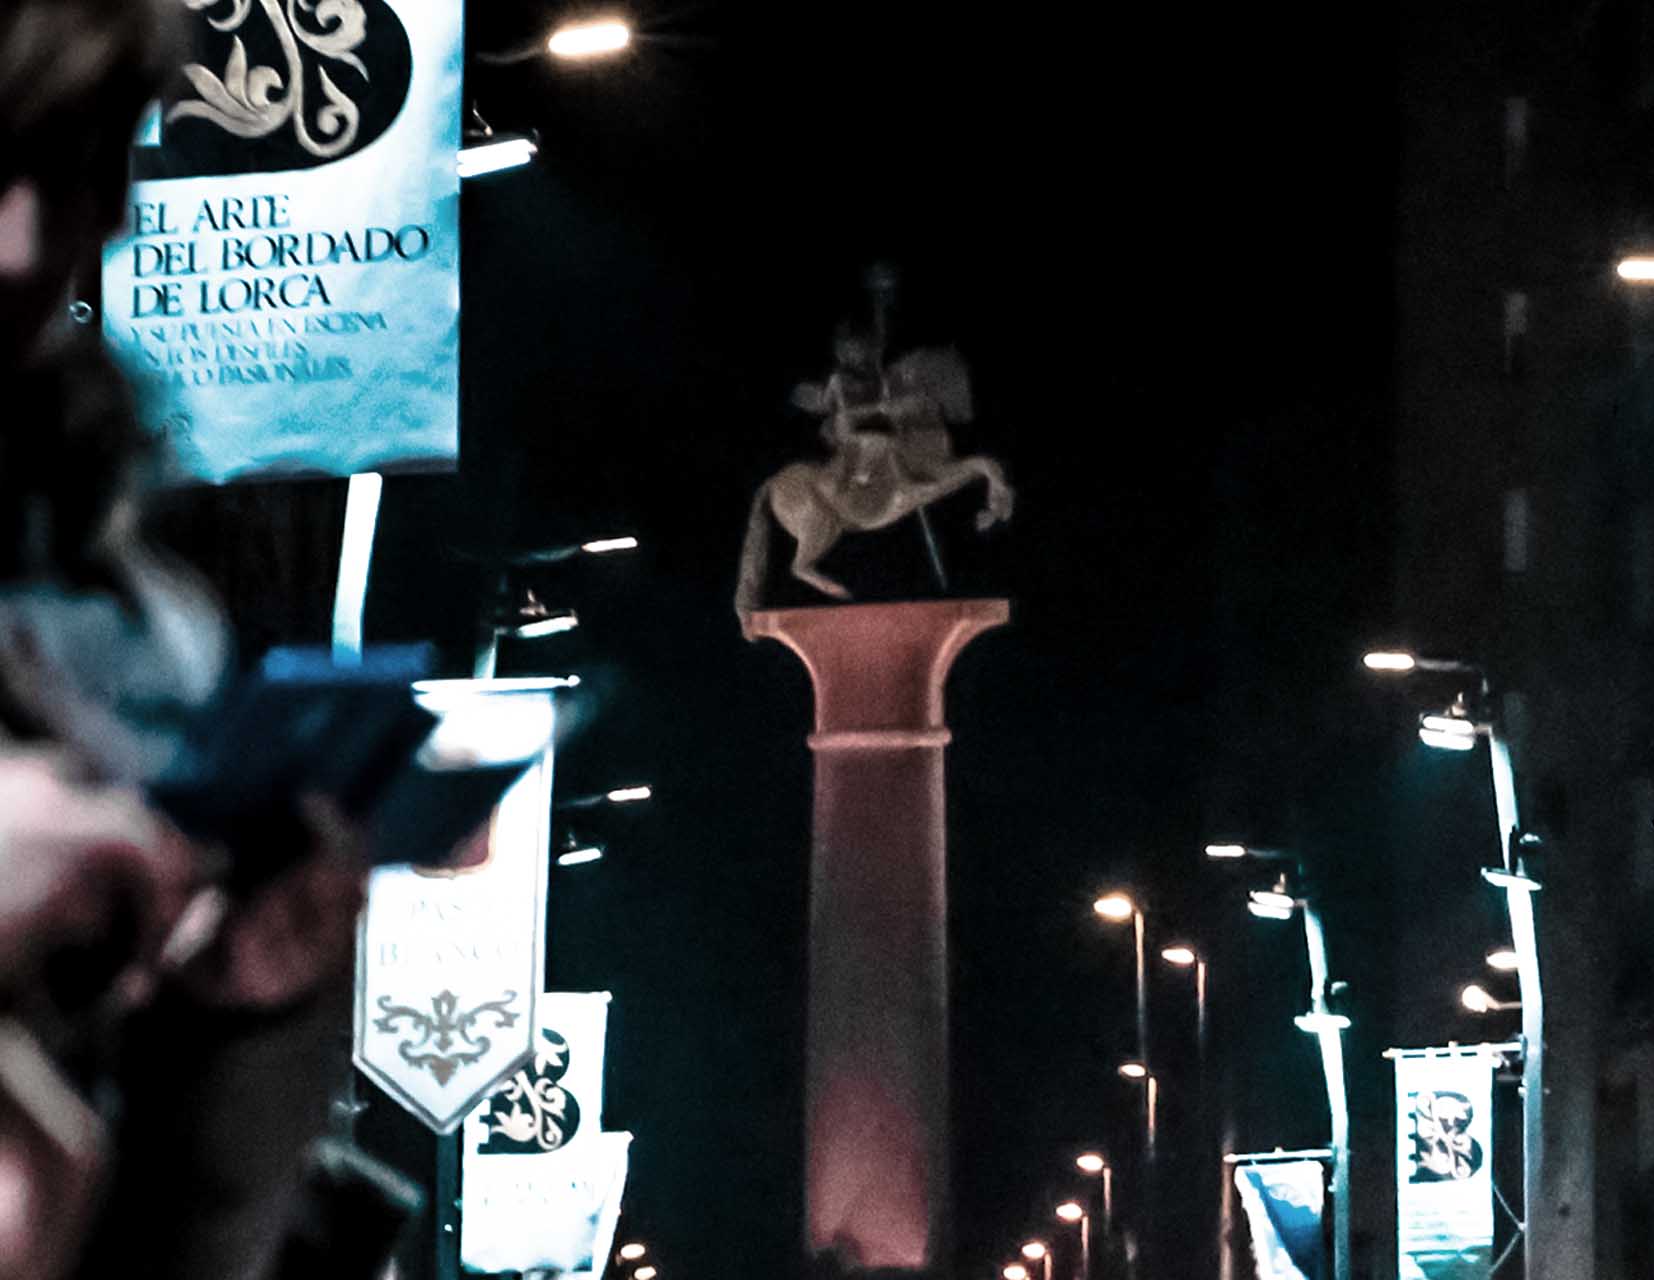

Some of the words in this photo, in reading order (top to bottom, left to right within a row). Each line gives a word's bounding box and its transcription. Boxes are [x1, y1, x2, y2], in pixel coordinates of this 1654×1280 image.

[133, 202, 177, 236] EL
[192, 194, 291, 233] ARTE
[132, 239, 207, 277] DEL
[221, 224, 430, 271] BORDADO
[131, 282, 184, 318] DE
[200, 273, 331, 314] LORCA
